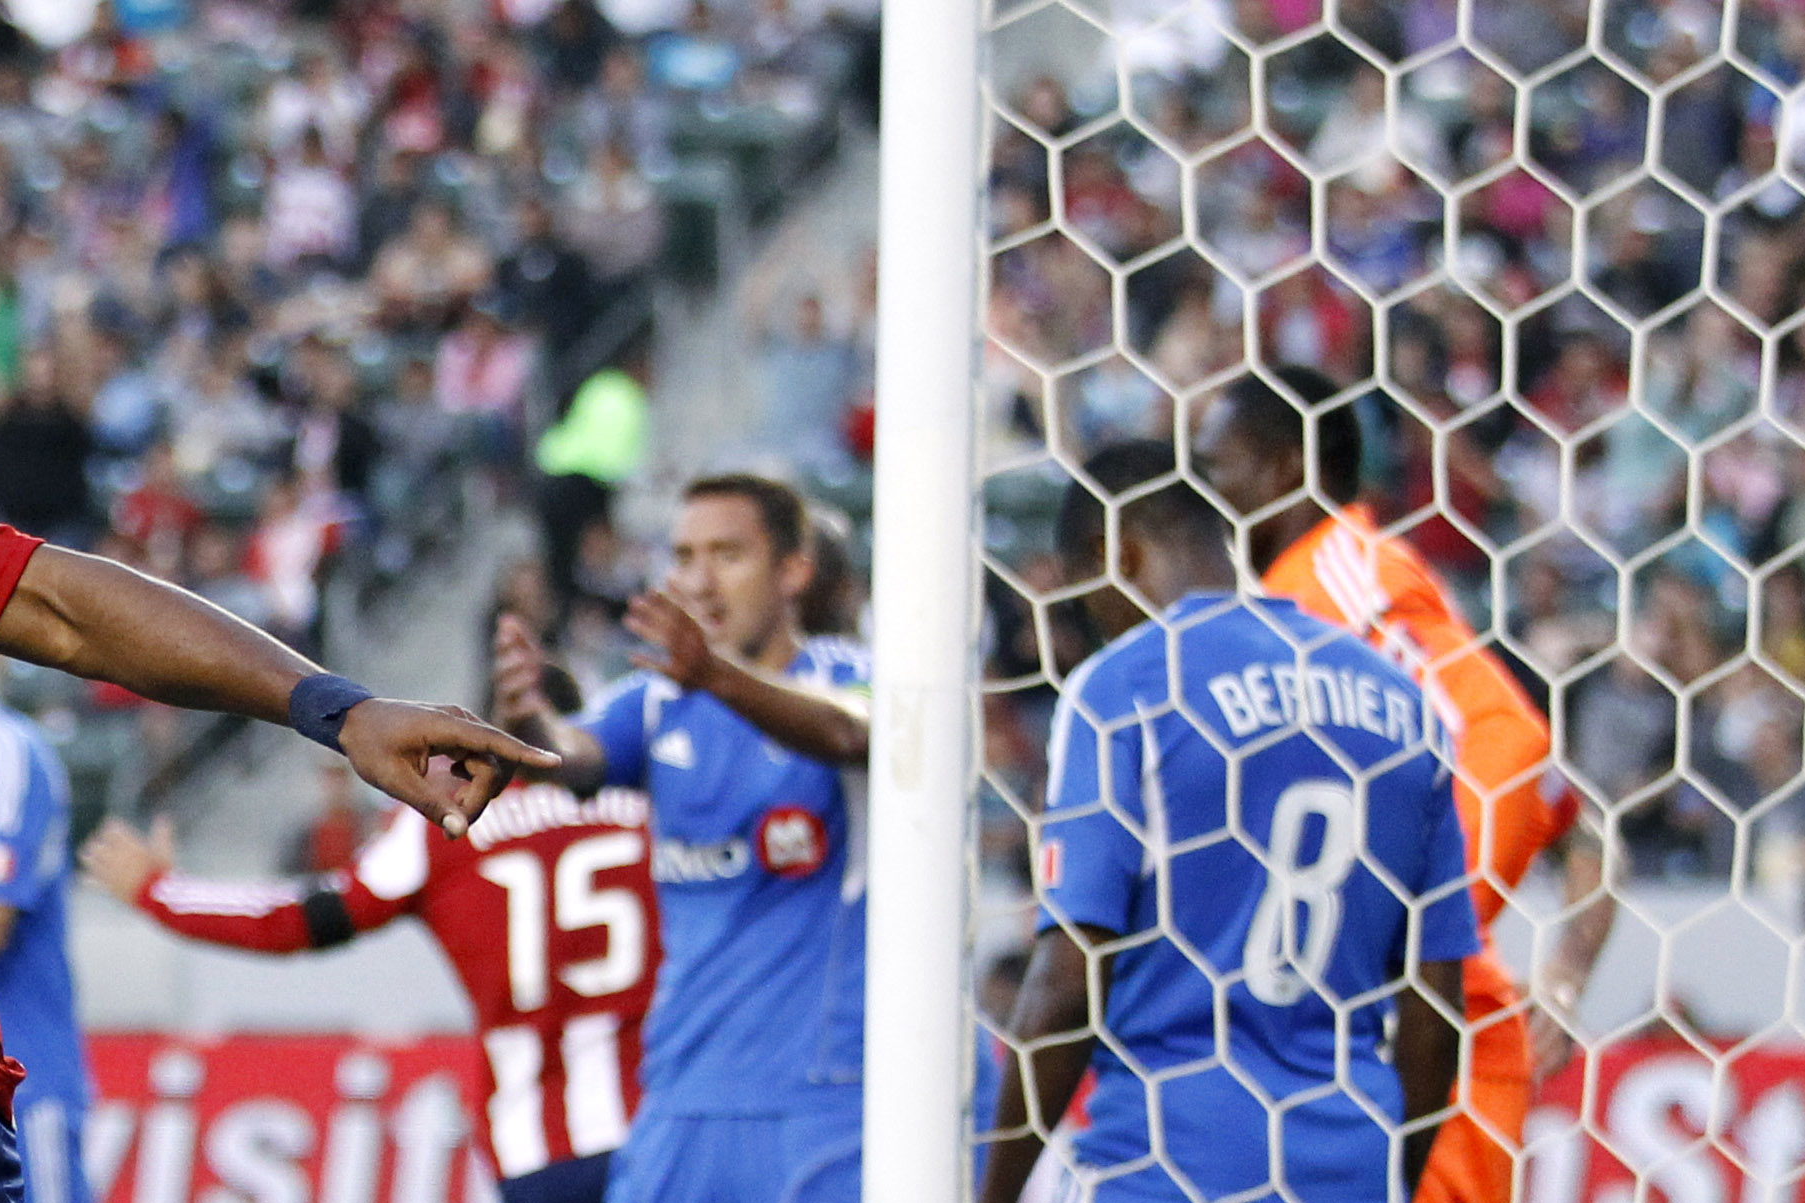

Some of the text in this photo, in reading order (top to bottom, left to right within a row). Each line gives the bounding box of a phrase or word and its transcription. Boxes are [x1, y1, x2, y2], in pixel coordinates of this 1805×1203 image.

[1207, 662, 1422, 752] BERNIER
[478, 831, 650, 1013] 15
[1242, 779, 1362, 1007] 8
